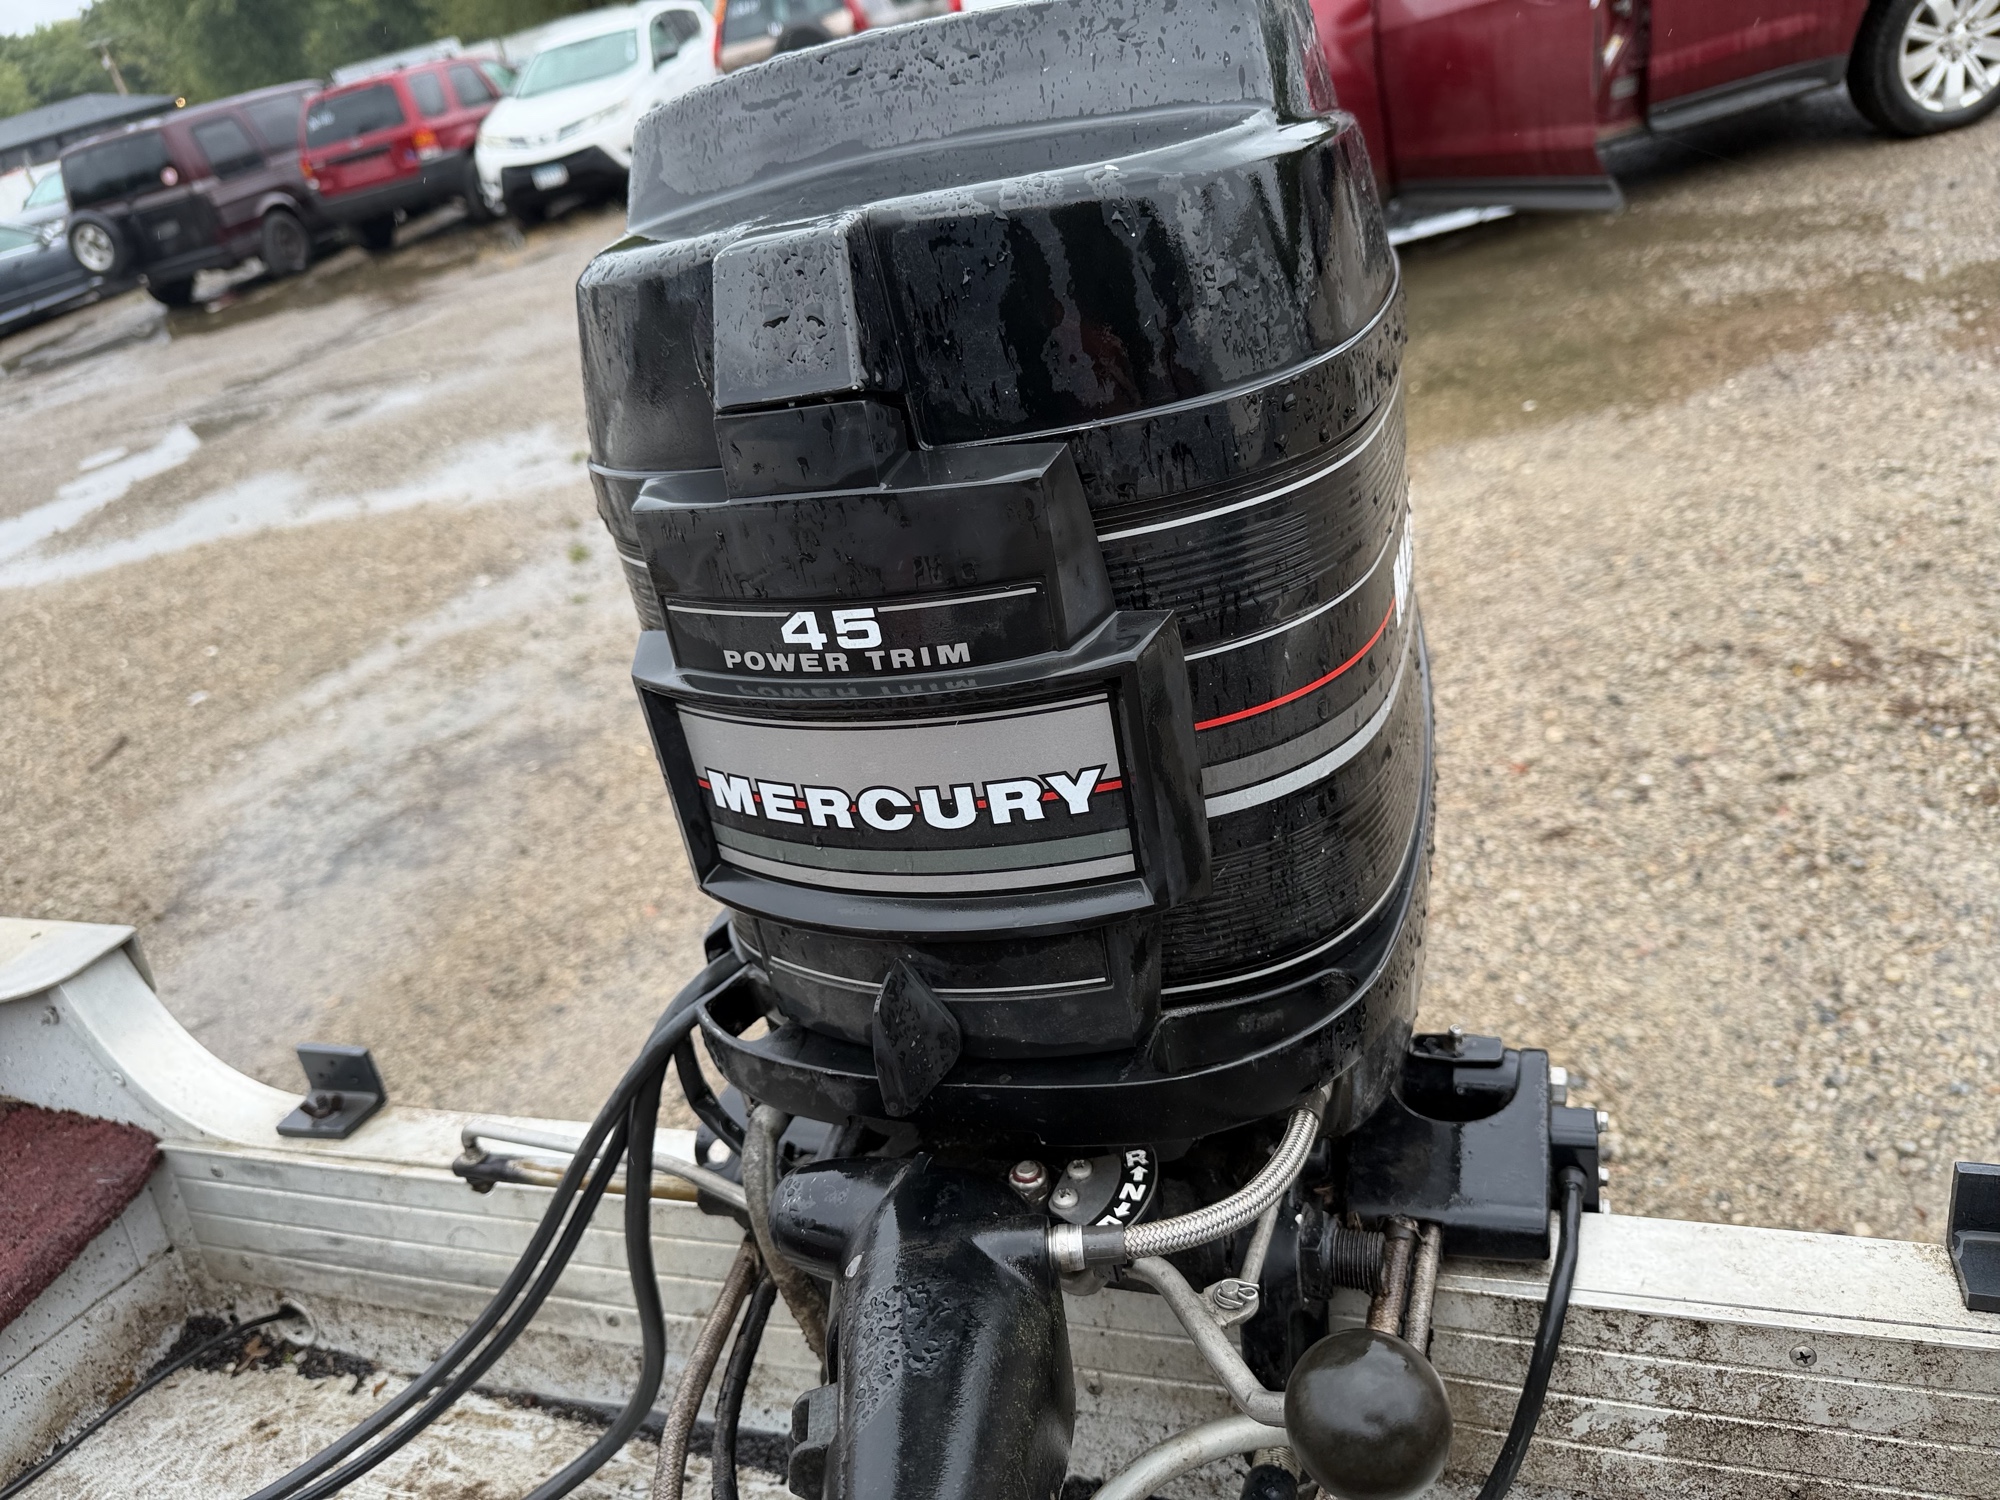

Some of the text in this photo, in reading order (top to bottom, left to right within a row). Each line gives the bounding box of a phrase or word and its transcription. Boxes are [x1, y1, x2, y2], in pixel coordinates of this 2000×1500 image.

[781, 608, 882, 650] 45
[723, 642, 971, 672] POWER TRIM
[705, 763, 1107, 832] MERCURY
[1125, 1149, 1149, 1168] R
[1119, 1182, 1147, 1201] N
